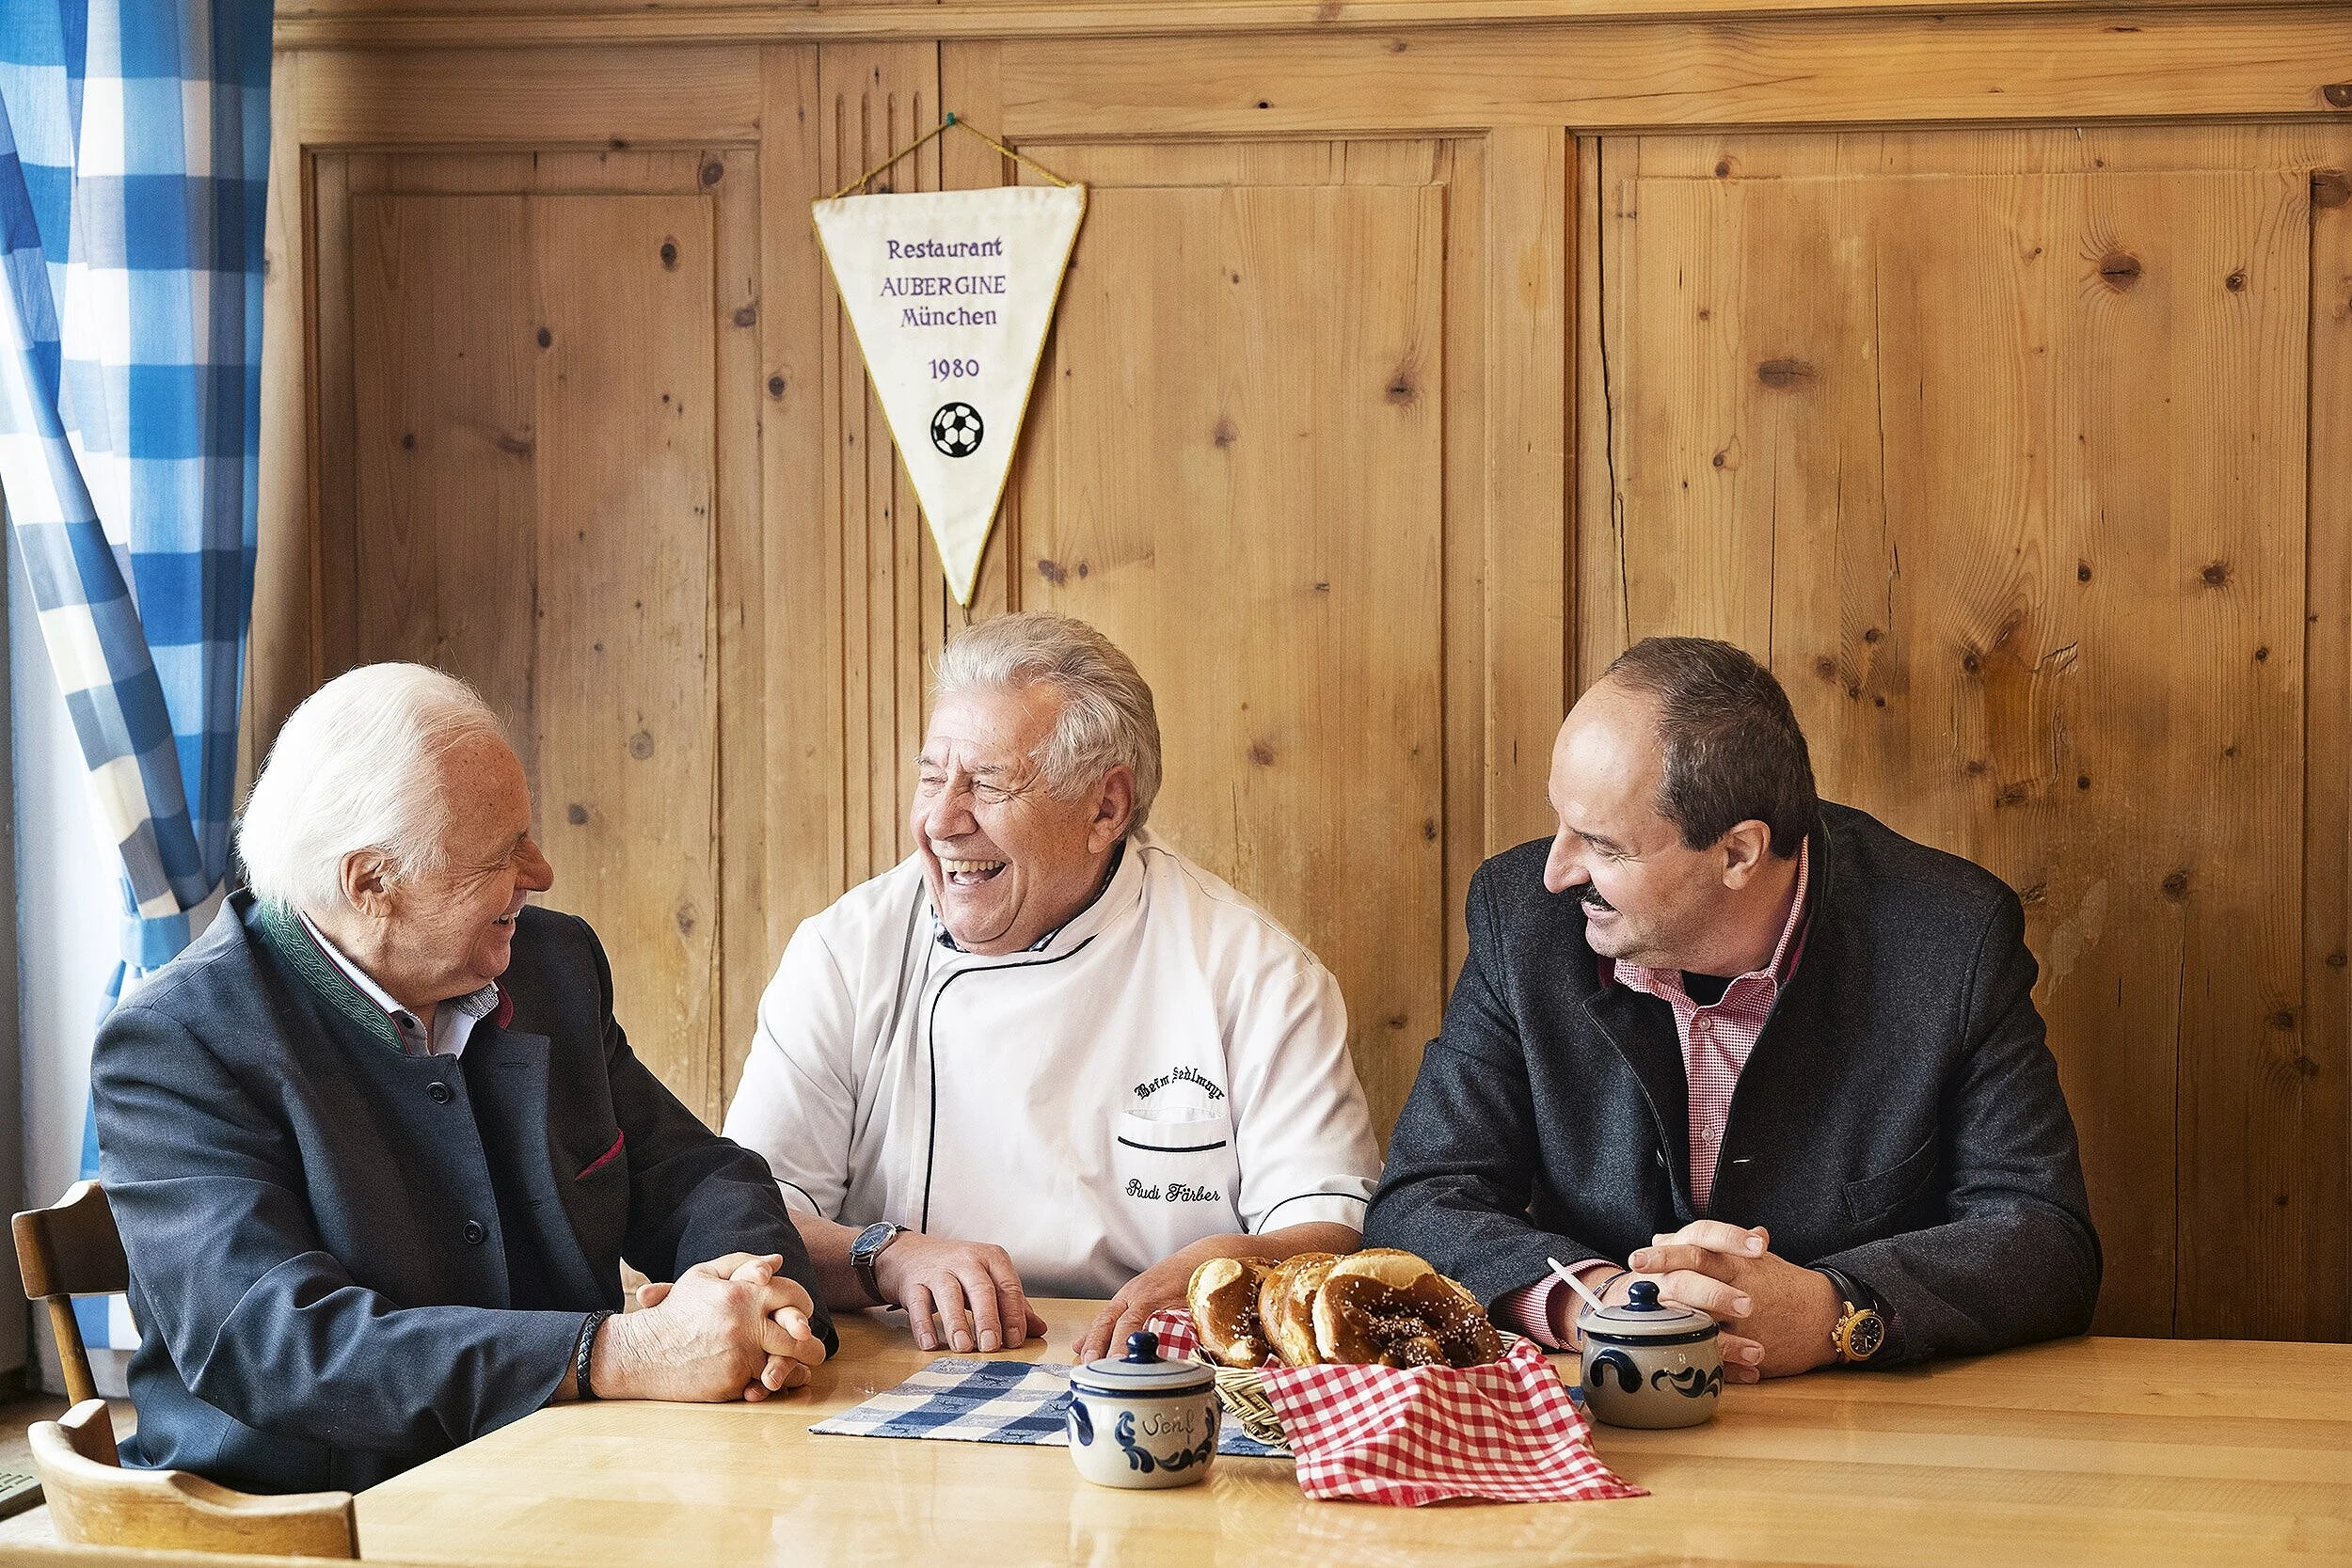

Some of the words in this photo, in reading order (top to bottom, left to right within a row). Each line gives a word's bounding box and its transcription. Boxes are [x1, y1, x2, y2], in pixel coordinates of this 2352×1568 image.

[886, 236, 1003, 260] Restaurant
[880, 275, 1007, 297] AUBERGINE
[900, 307, 997, 328] München
[928, 358, 979, 382] 1980
[1134, 1074, 1170, 1101] Beim
[1171, 1066, 1225, 1101] Sedlmayr
[1125, 1178, 1161, 1200] Rudi
[1165, 1182, 1221, 1203] Färber
[1142, 1410, 1194, 1445] Senf
